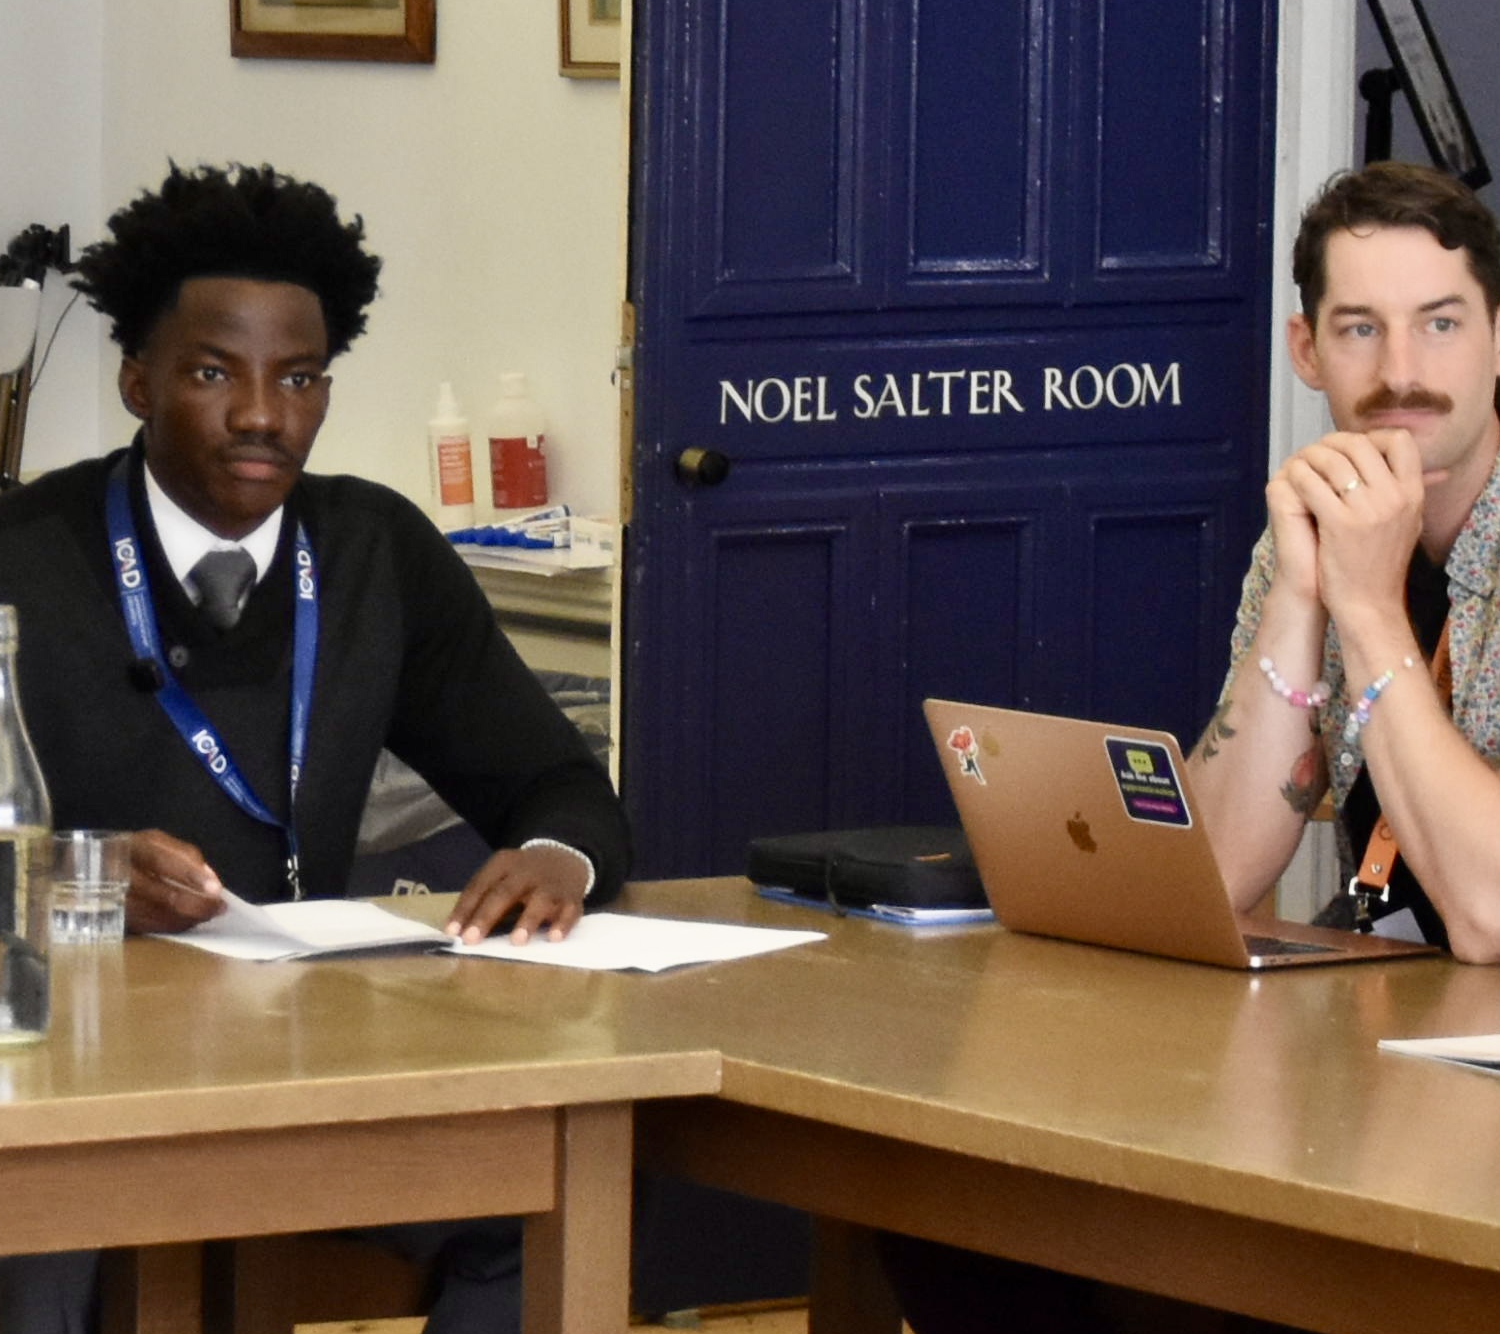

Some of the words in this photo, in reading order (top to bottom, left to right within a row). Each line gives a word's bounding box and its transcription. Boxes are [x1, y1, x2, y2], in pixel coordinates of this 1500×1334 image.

[719, 377, 838, 424] NOEL
[852, 369, 1026, 418] SALTER
[1042, 362, 1182, 412] ROOM
[114, 537, 142, 588] ICAD
[191, 728, 228, 775] ICAD
